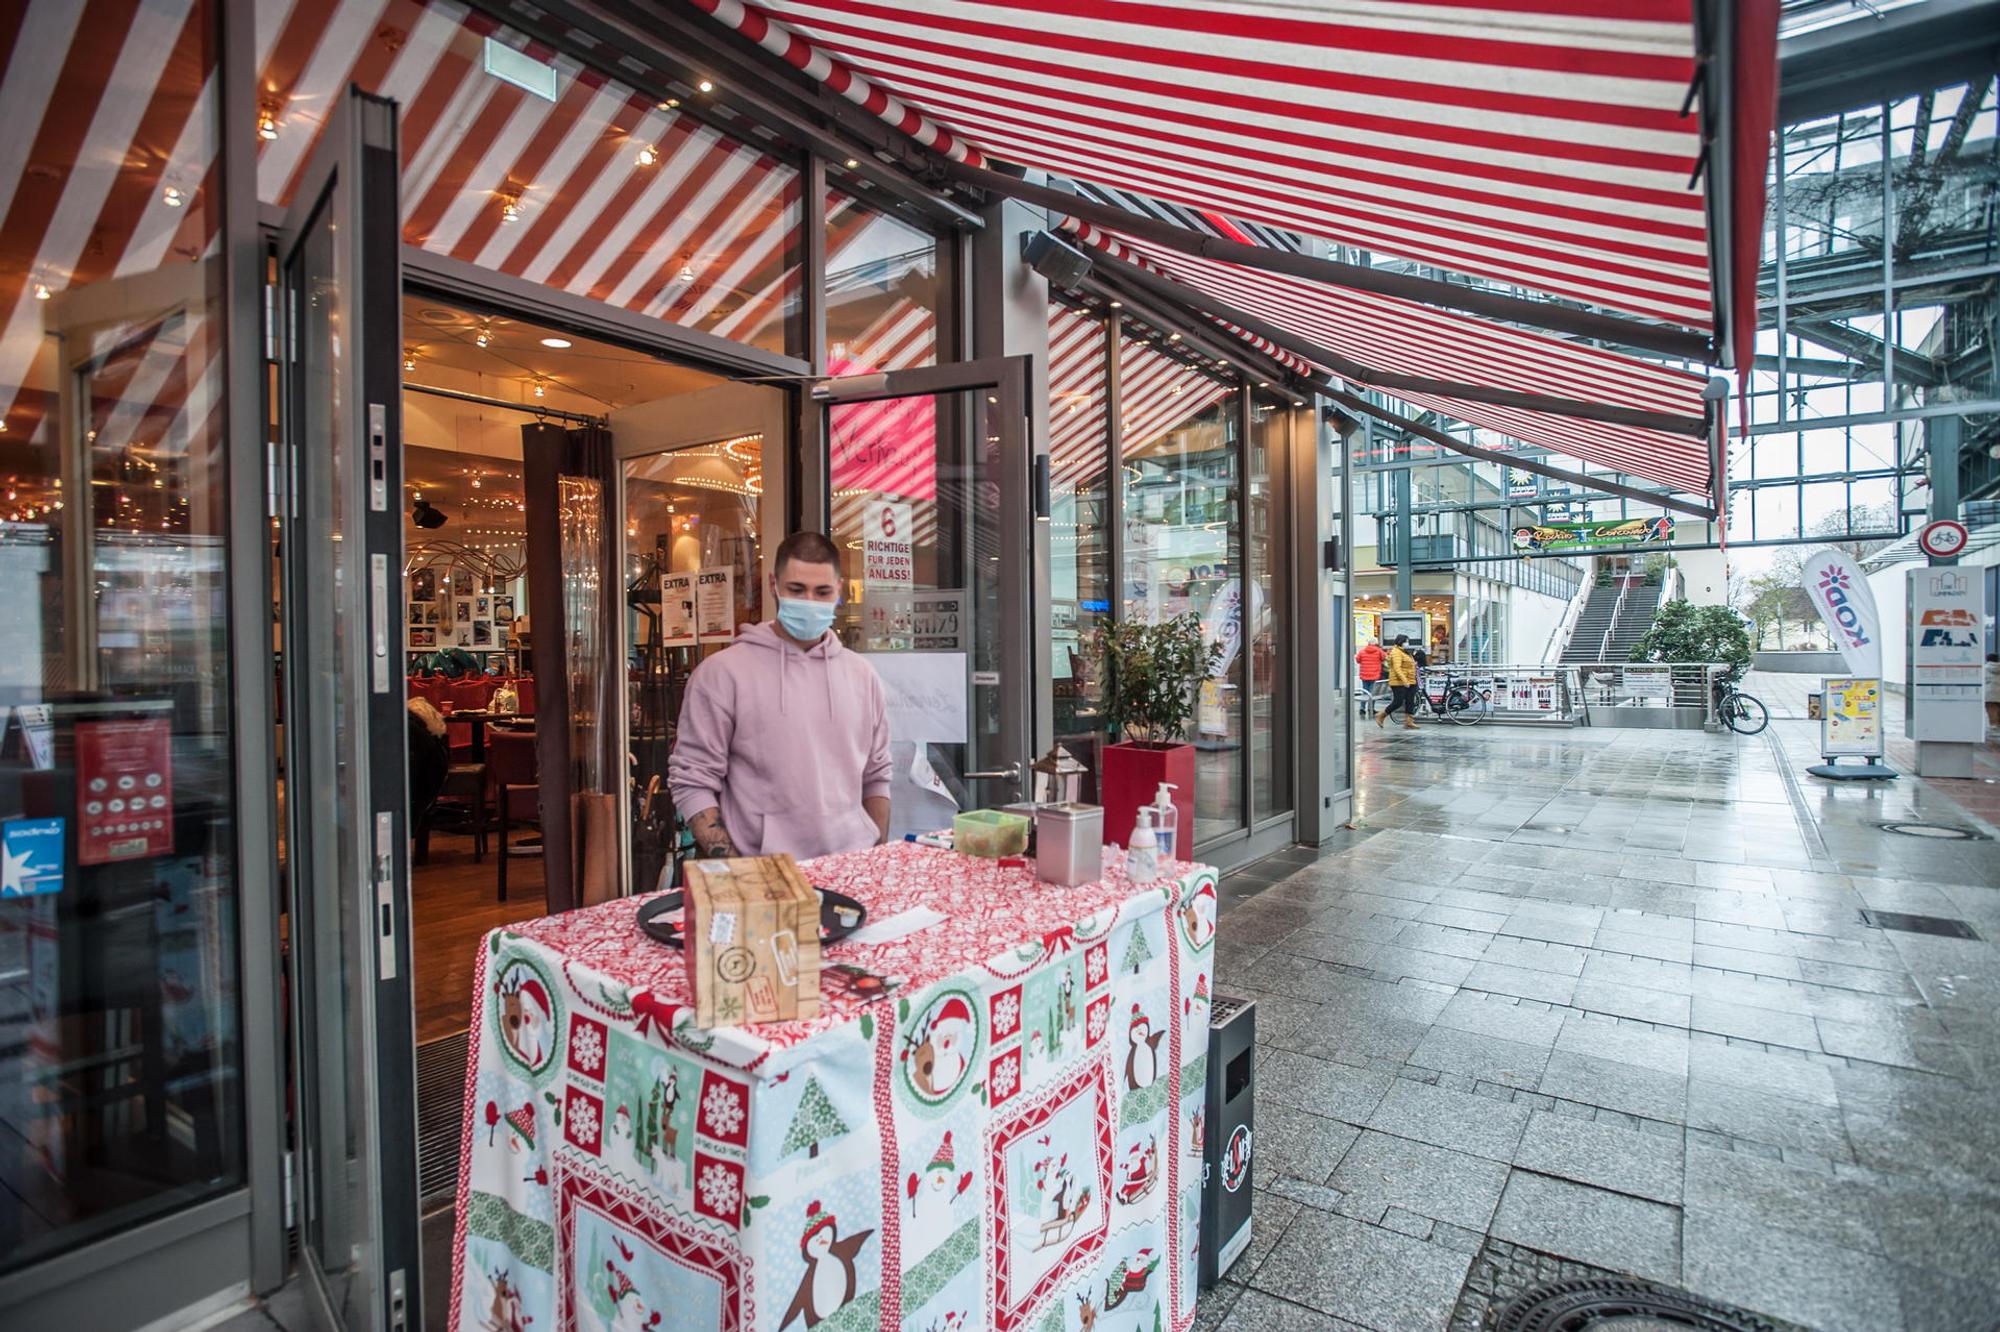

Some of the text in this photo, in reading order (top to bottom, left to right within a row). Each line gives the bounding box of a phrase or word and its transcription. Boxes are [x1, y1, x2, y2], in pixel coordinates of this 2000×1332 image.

[880, 506, 896, 538] 6
[868, 541, 910, 553] RICHTIGE
[886, 556, 910, 566] JEDEN
[699, 573, 727, 585] EXTRA
[868, 567, 911, 580] ANLASS!
[664, 577, 689, 589] EXTRA
